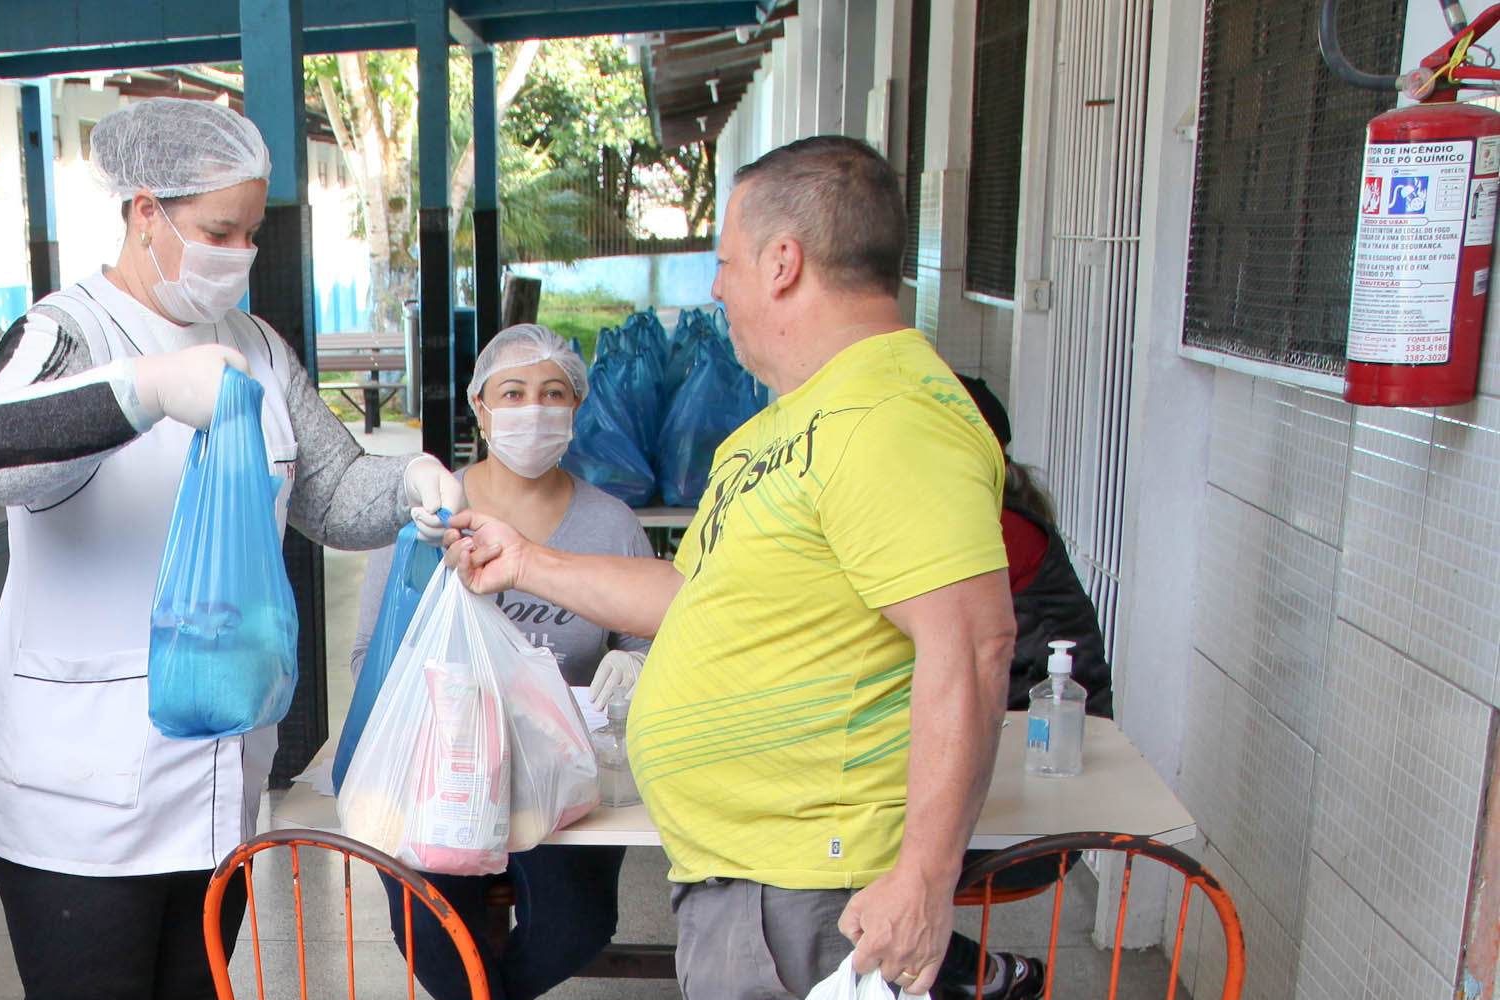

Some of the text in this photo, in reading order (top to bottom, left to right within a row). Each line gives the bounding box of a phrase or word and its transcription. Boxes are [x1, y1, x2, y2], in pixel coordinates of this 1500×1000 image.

[1384, 147, 1396, 155] DE
[1399, 145, 1454, 154] INCÊNDIO
[1382, 156, 1394, 164] DE
[1415, 154, 1464, 163] QUÍMICO
[1400, 233, 1433, 241] DISTÂNCIA
